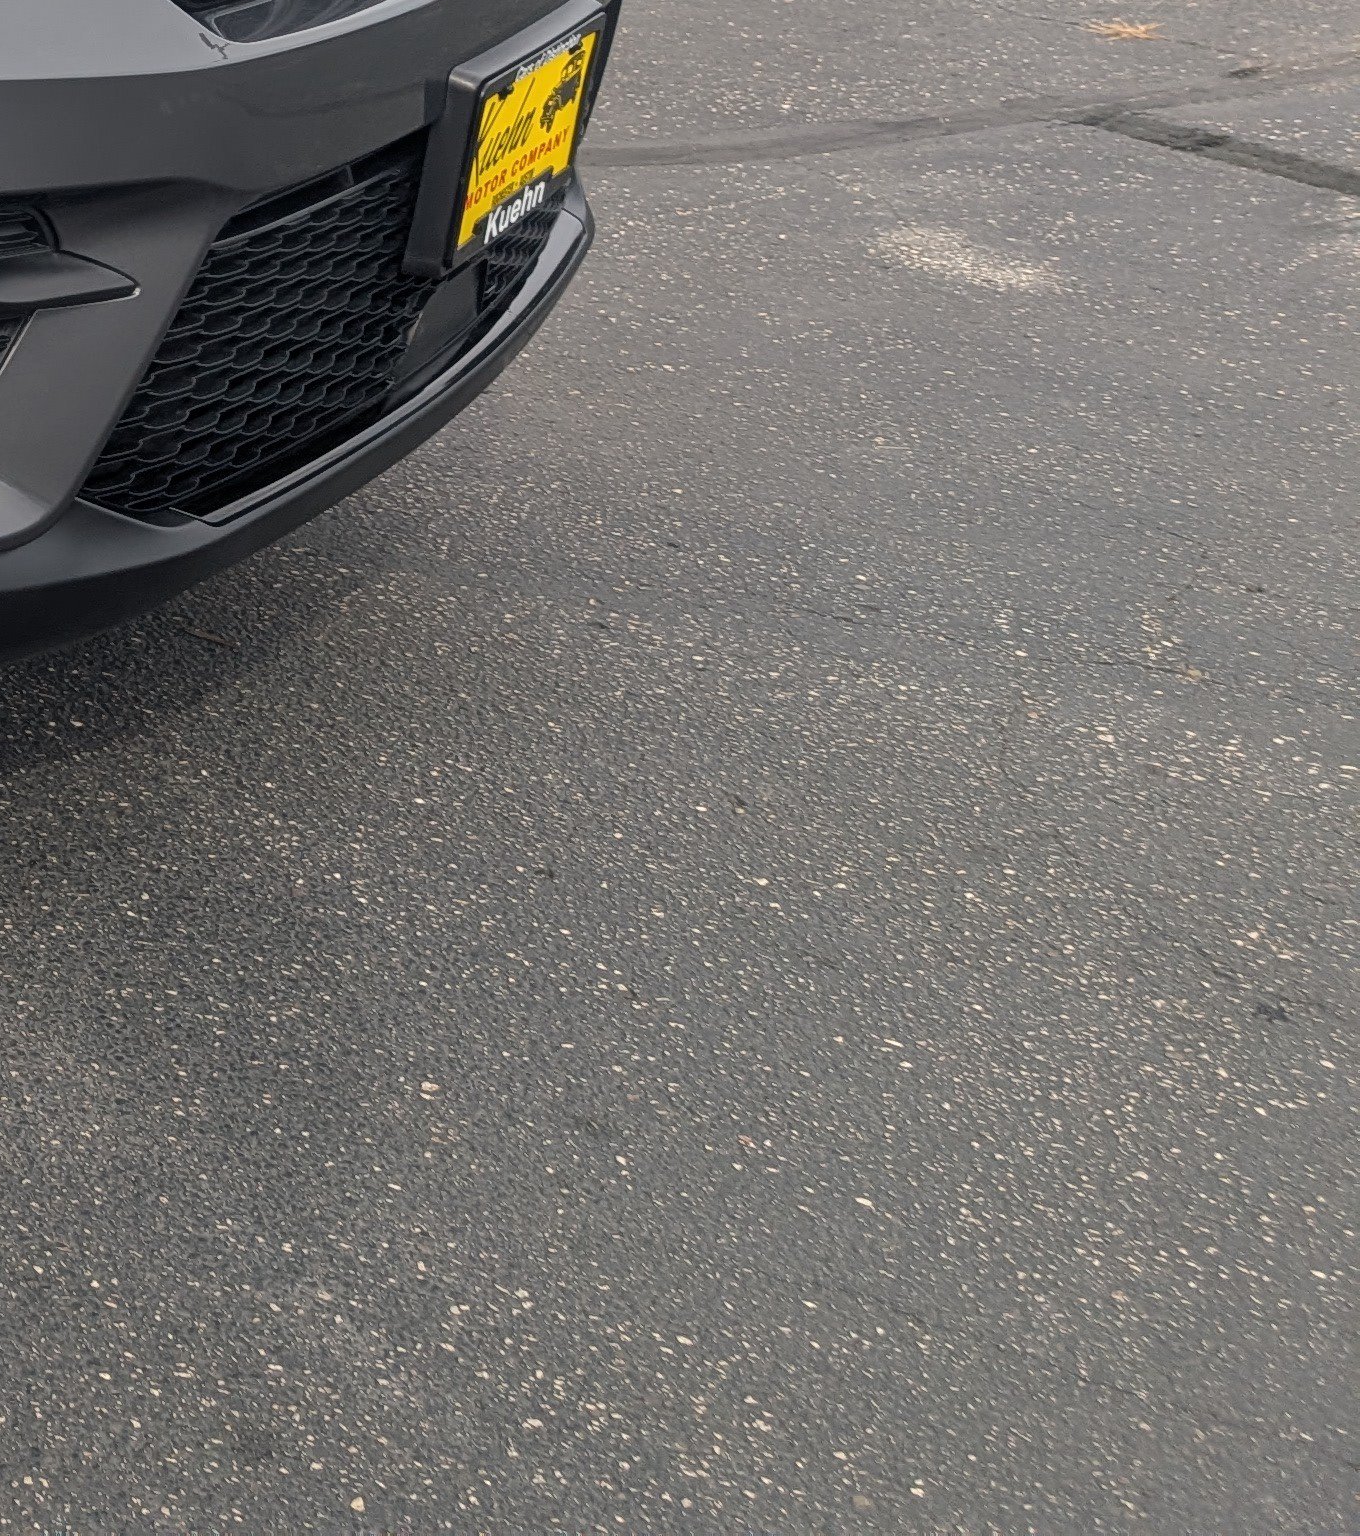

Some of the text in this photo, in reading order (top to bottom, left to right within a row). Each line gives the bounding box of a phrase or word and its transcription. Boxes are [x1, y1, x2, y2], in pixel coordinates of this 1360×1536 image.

[463, 168, 507, 211] MOTOR
[510, 125, 570, 177] COMPANY
[473, 76, 537, 187] Kuehn
[483, 180, 546, 245] Kuehn
